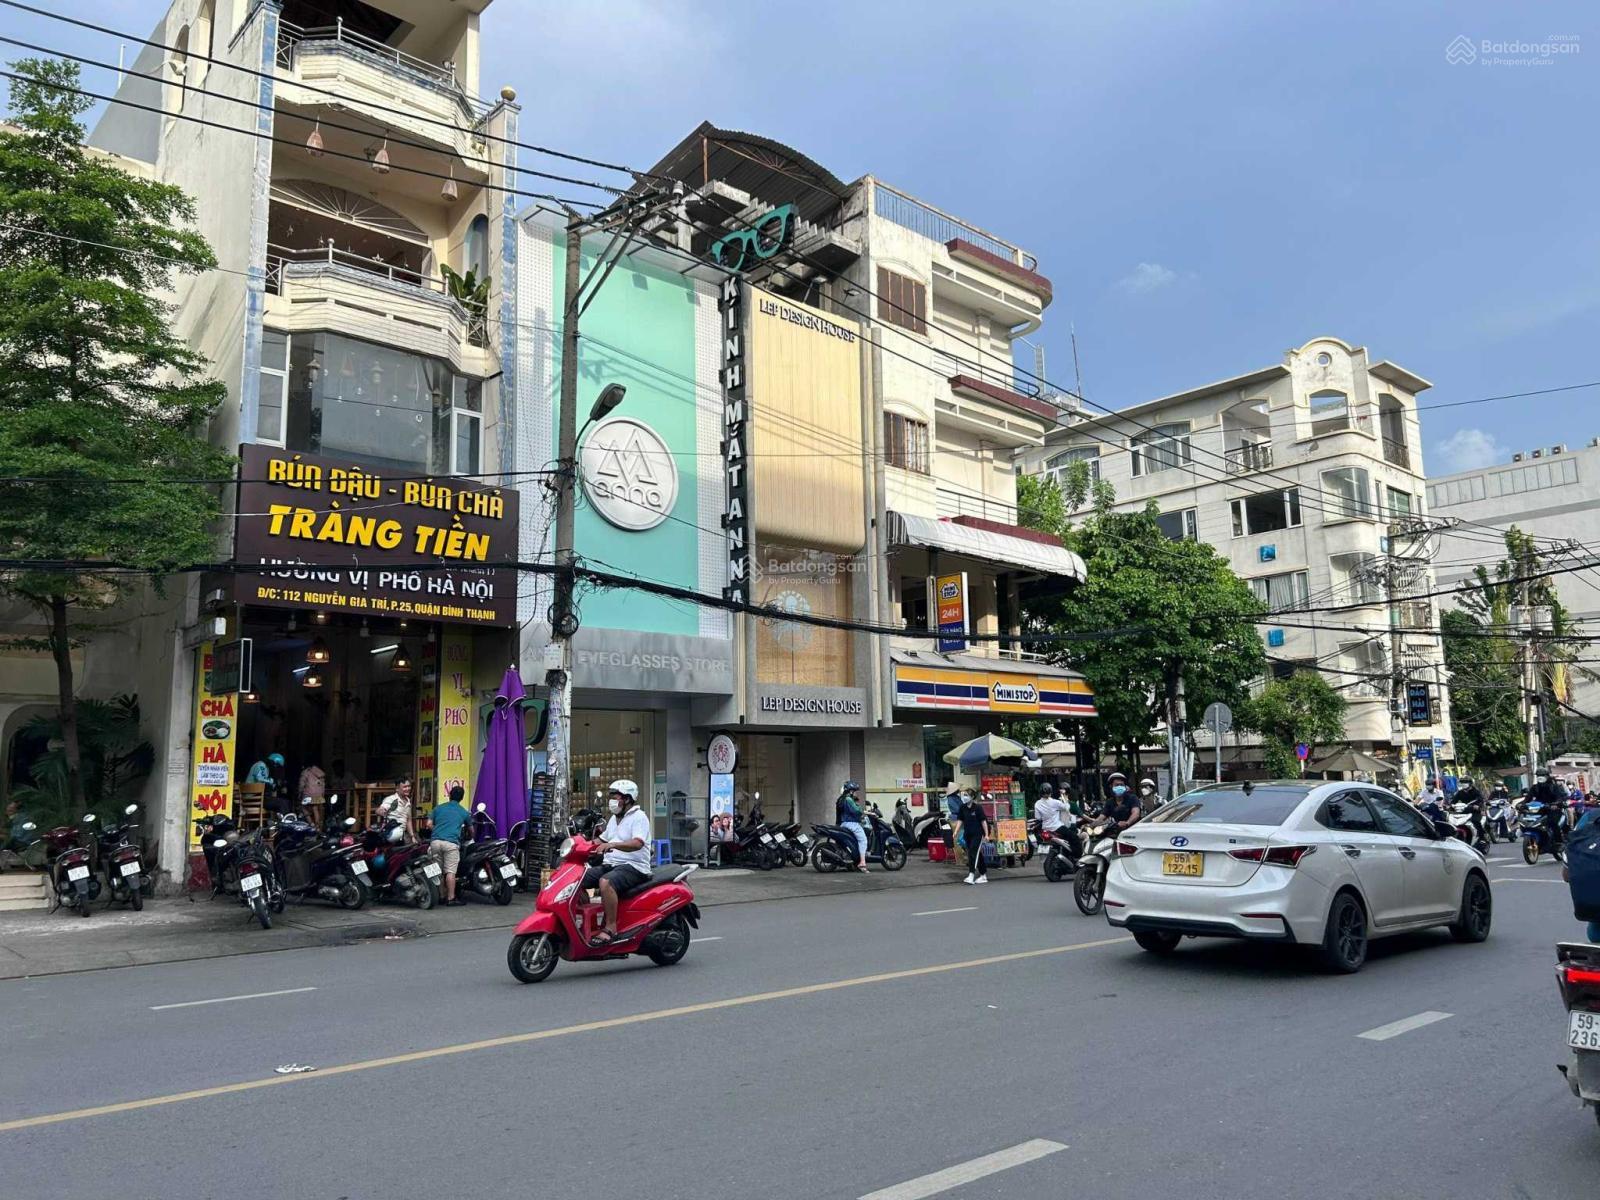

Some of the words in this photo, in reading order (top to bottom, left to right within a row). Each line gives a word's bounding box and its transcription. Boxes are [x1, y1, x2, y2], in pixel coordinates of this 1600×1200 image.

[723, 276, 741, 390] KÍNH
[780, 306, 820, 331] DESIGN
[820, 320, 856, 343] HOUSE
[458, 489, 504, 519] CHẢ
[269, 500, 403, 549] TRÀNG
[415, 514, 490, 561] TIỀN
[427, 573, 455, 596] HÀ
[462, 578, 494, 603] NỘI
[283, 590, 301, 602] 112
[304, 590, 346, 606] NGUYỄN
[350, 596, 368, 608] GIA
[414, 603, 440, 616] QUẬN
[466, 608, 496, 621] THẠNH
[942, 607, 959, 619] 24H
[685, 656, 729, 673] STORE
[762, 696, 782, 712] LEP
[783, 698, 824, 713] DESIGN
[825, 700, 862, 714] HOUSE
